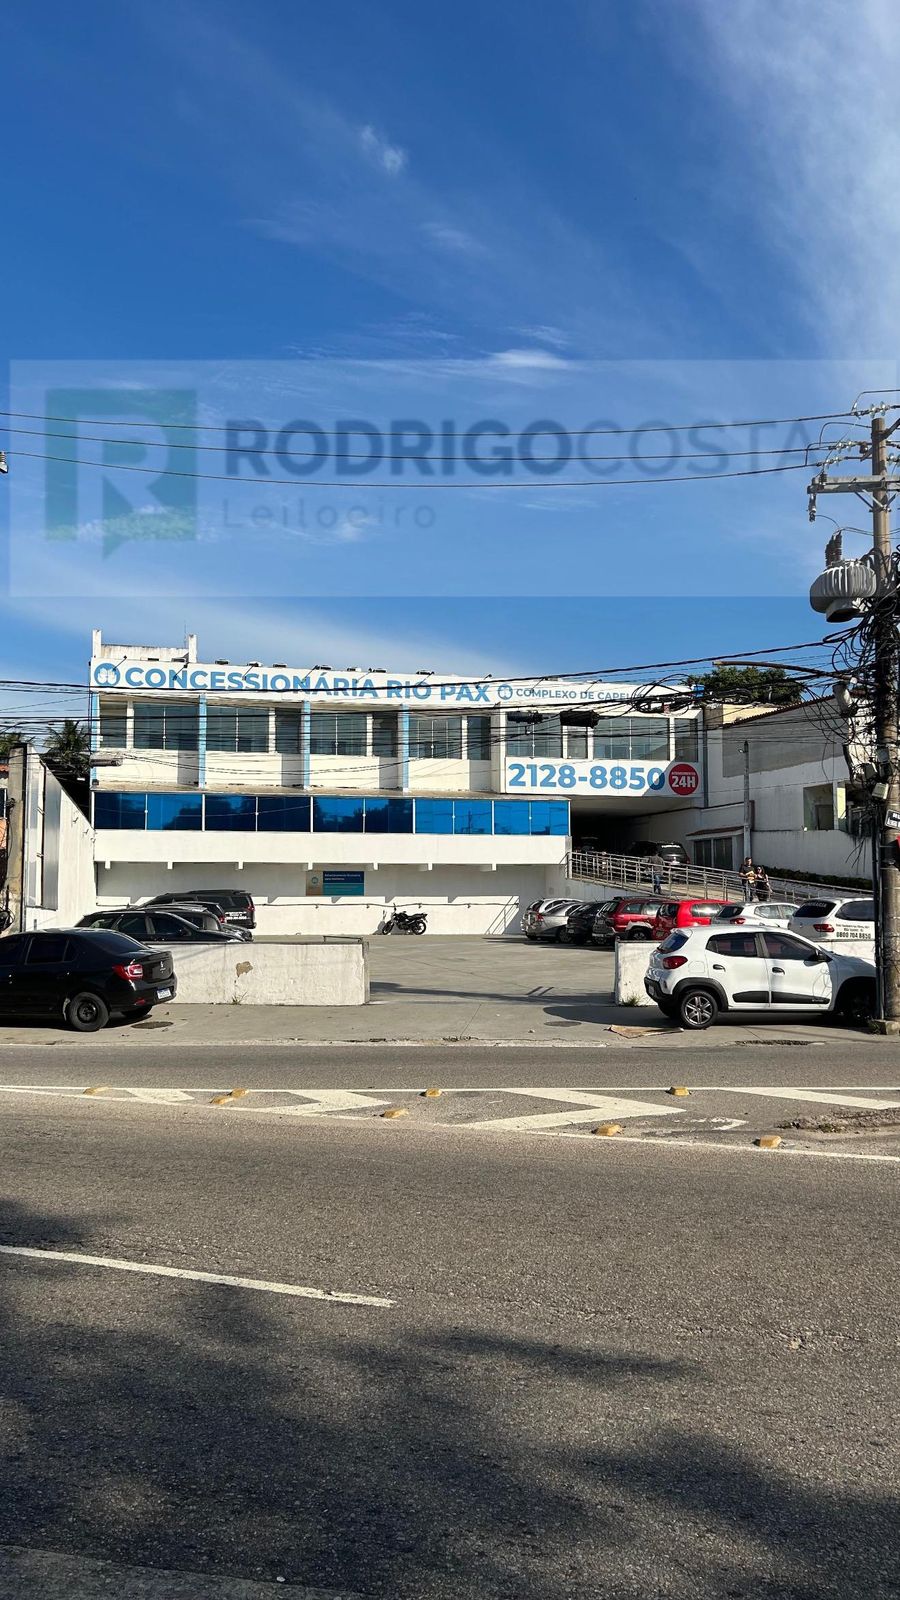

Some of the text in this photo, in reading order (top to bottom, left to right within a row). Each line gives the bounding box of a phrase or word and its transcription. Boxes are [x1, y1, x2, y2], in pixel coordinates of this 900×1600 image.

[125, 667, 490, 702] CONCESSIONÁRIA RIO PAX
[516, 688, 577, 699] COMPLEXO
[580, 691, 594, 700] DE
[508, 763, 666, 791] 2128-8850
[671, 775, 696, 788] 24H
